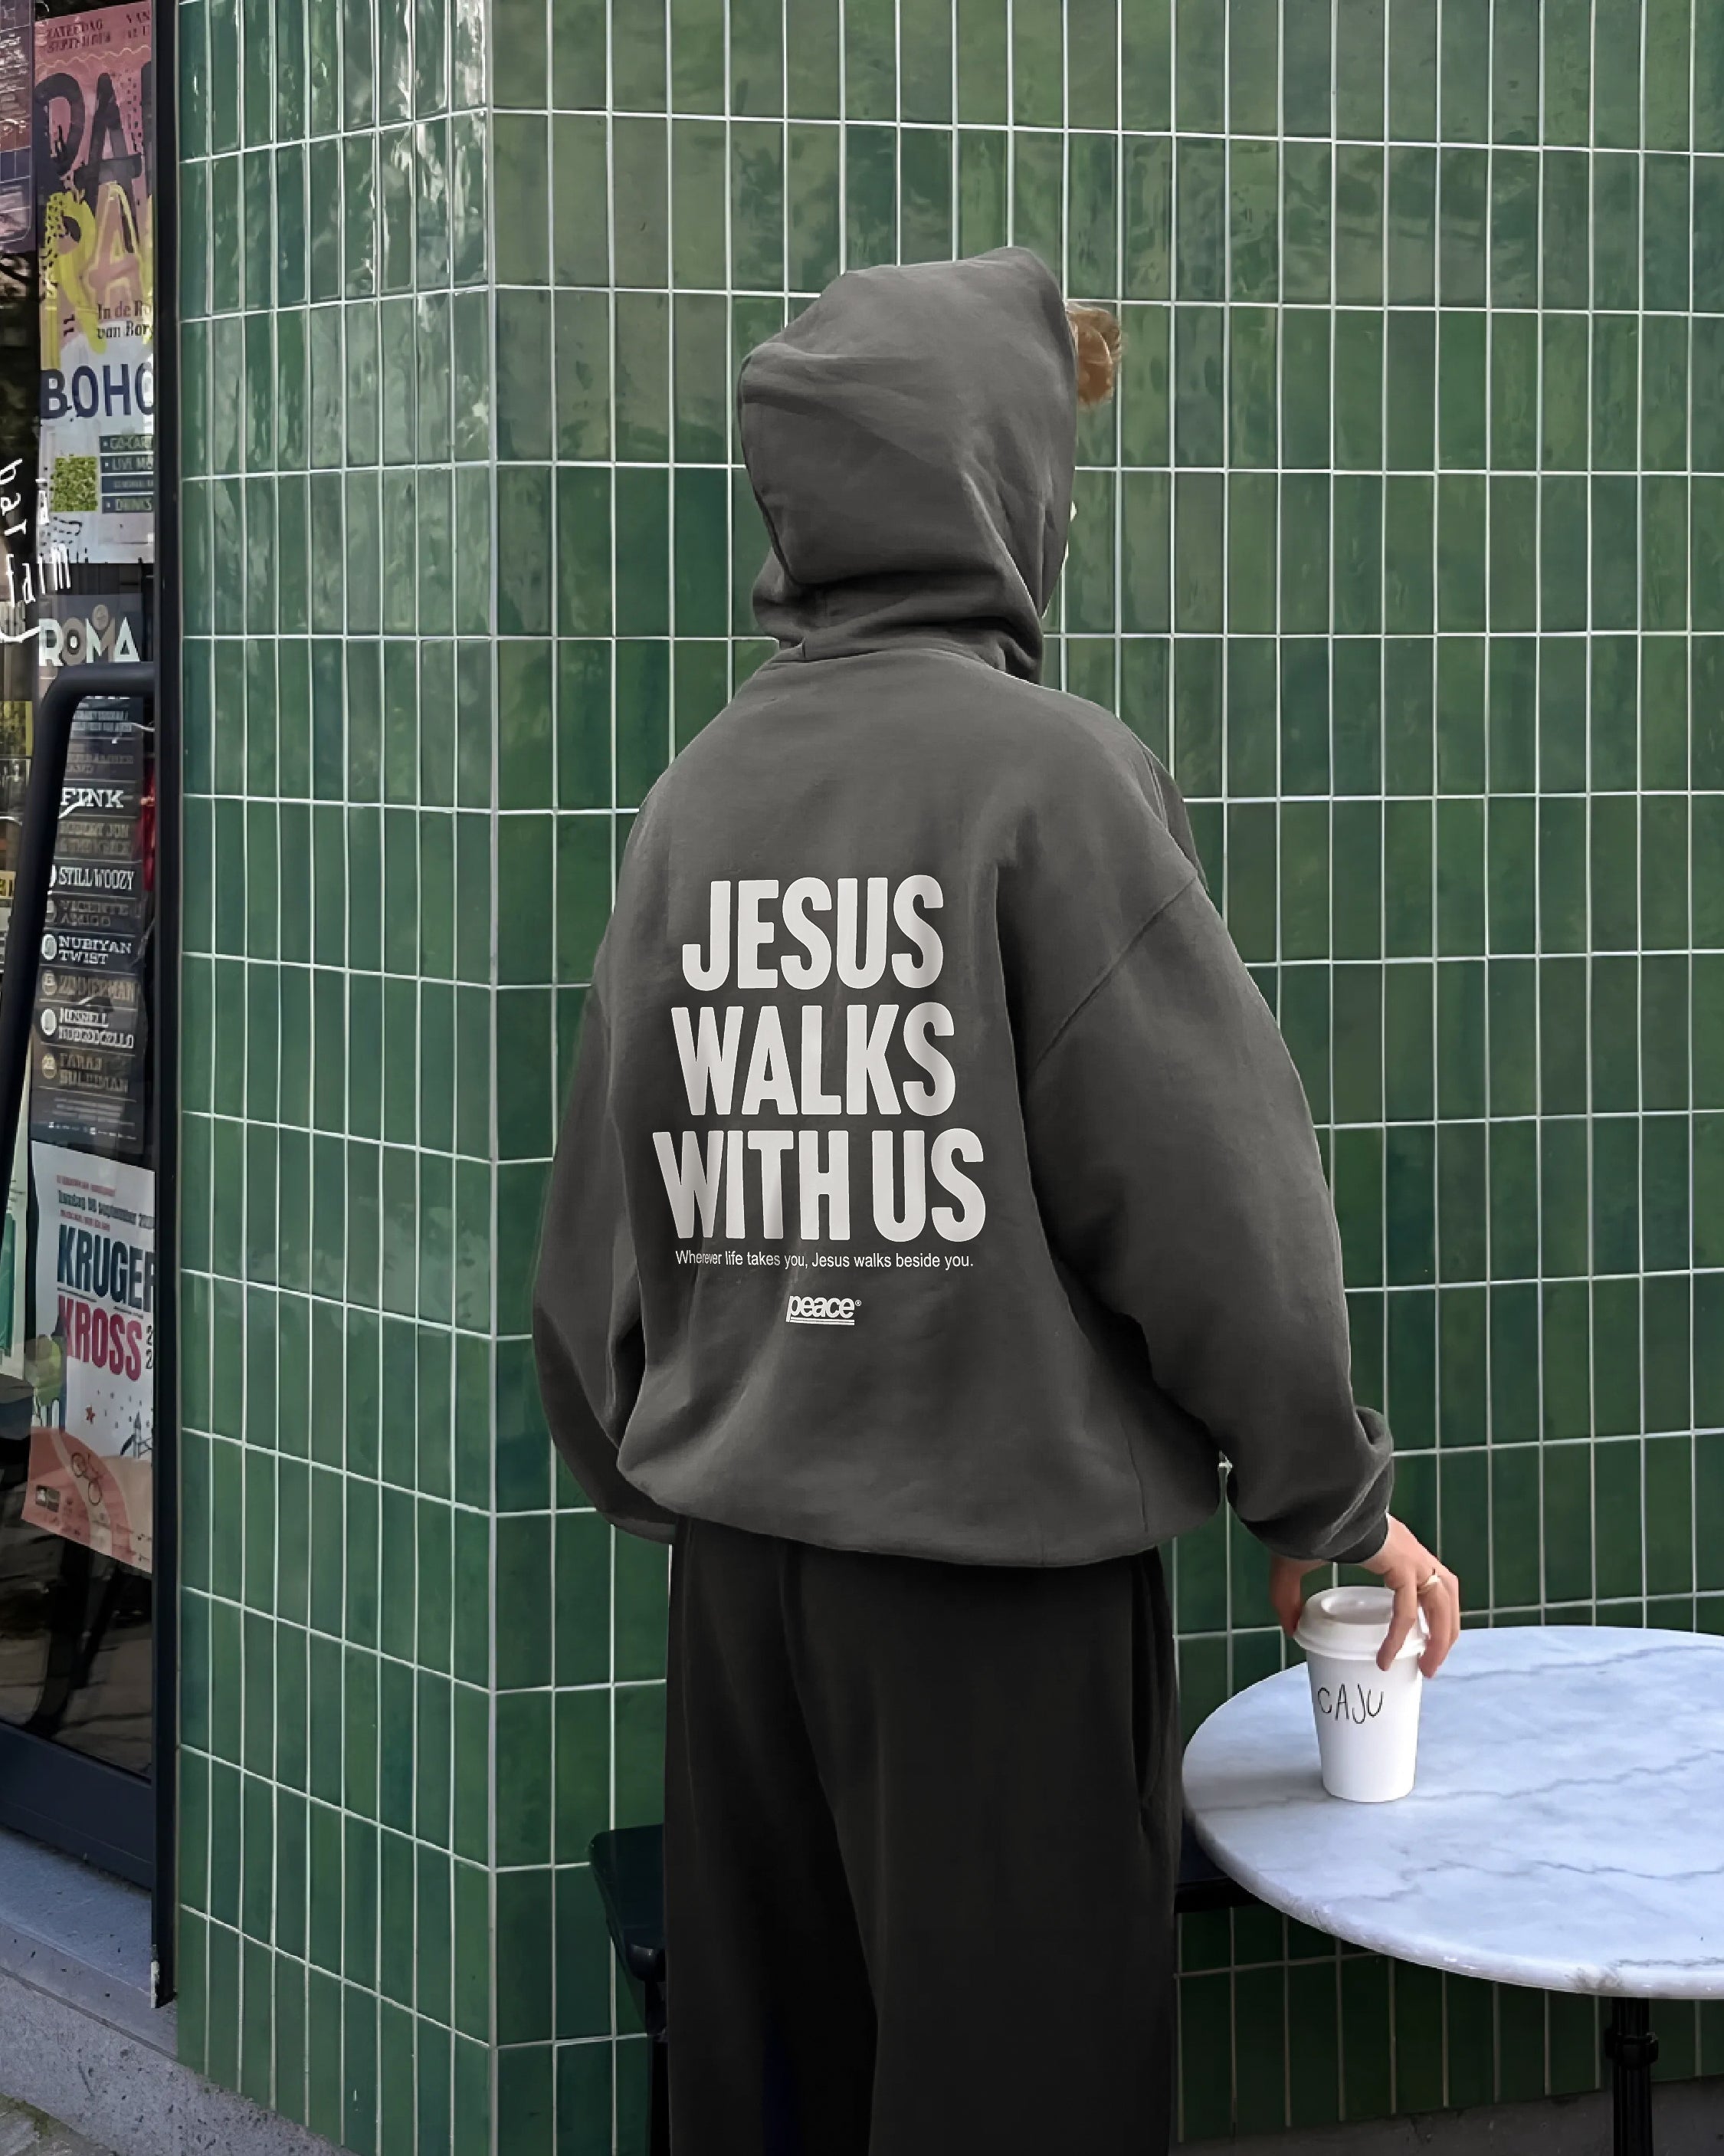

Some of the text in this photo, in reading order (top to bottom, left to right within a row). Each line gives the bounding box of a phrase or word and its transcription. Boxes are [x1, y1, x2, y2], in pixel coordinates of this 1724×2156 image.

[38, 616, 141, 667] ROMA
[61, 786, 124, 809] FINK
[682, 875, 944, 991] JESUS
[58, 950, 109, 965] TWIST
[670, 1002, 955, 1116] WALKS
[652, 1128, 986, 1242] WITH US
[675, 1249, 974, 1271] Wherever life takes you, Jesus walks beside you.
[1317, 1683, 1384, 1724] CAJU
